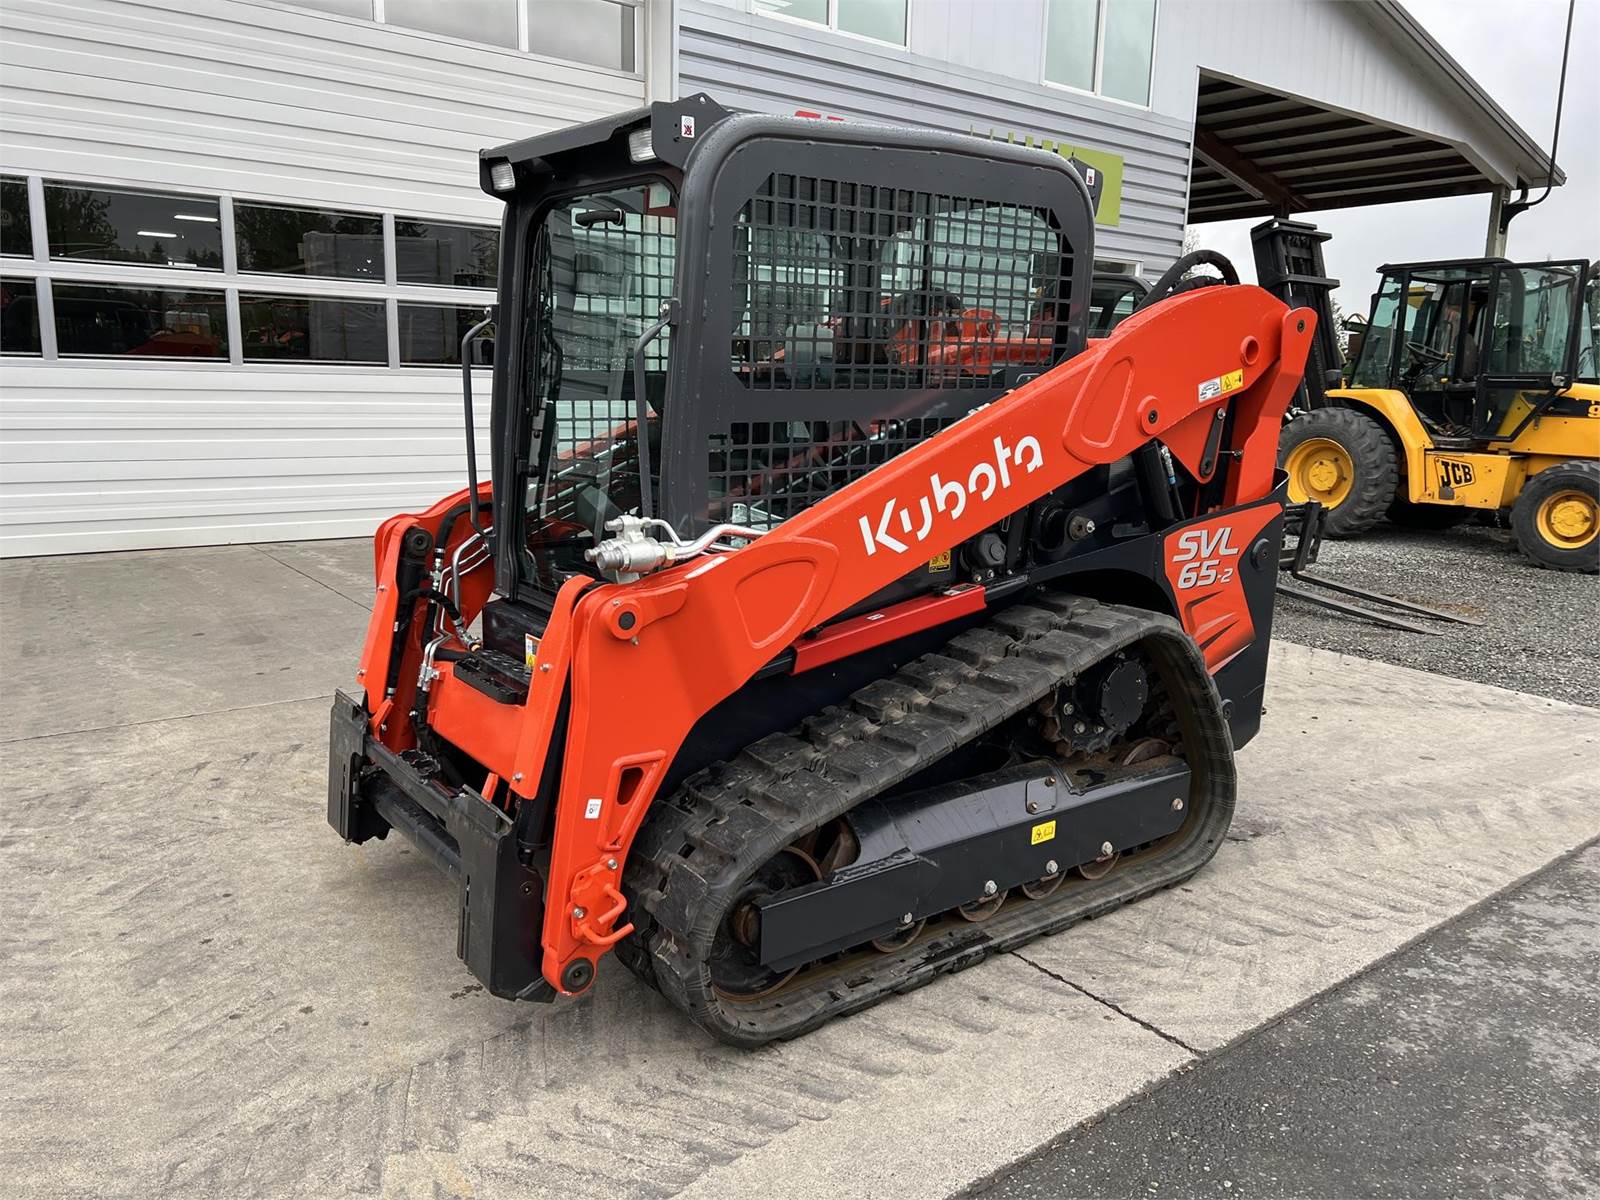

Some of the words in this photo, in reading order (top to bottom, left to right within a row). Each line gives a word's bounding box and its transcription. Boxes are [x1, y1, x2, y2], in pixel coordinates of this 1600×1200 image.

[1440, 460, 1472, 488] JCB
[858, 435, 1043, 556] Kubota
[1172, 527, 1239, 562] SVL
